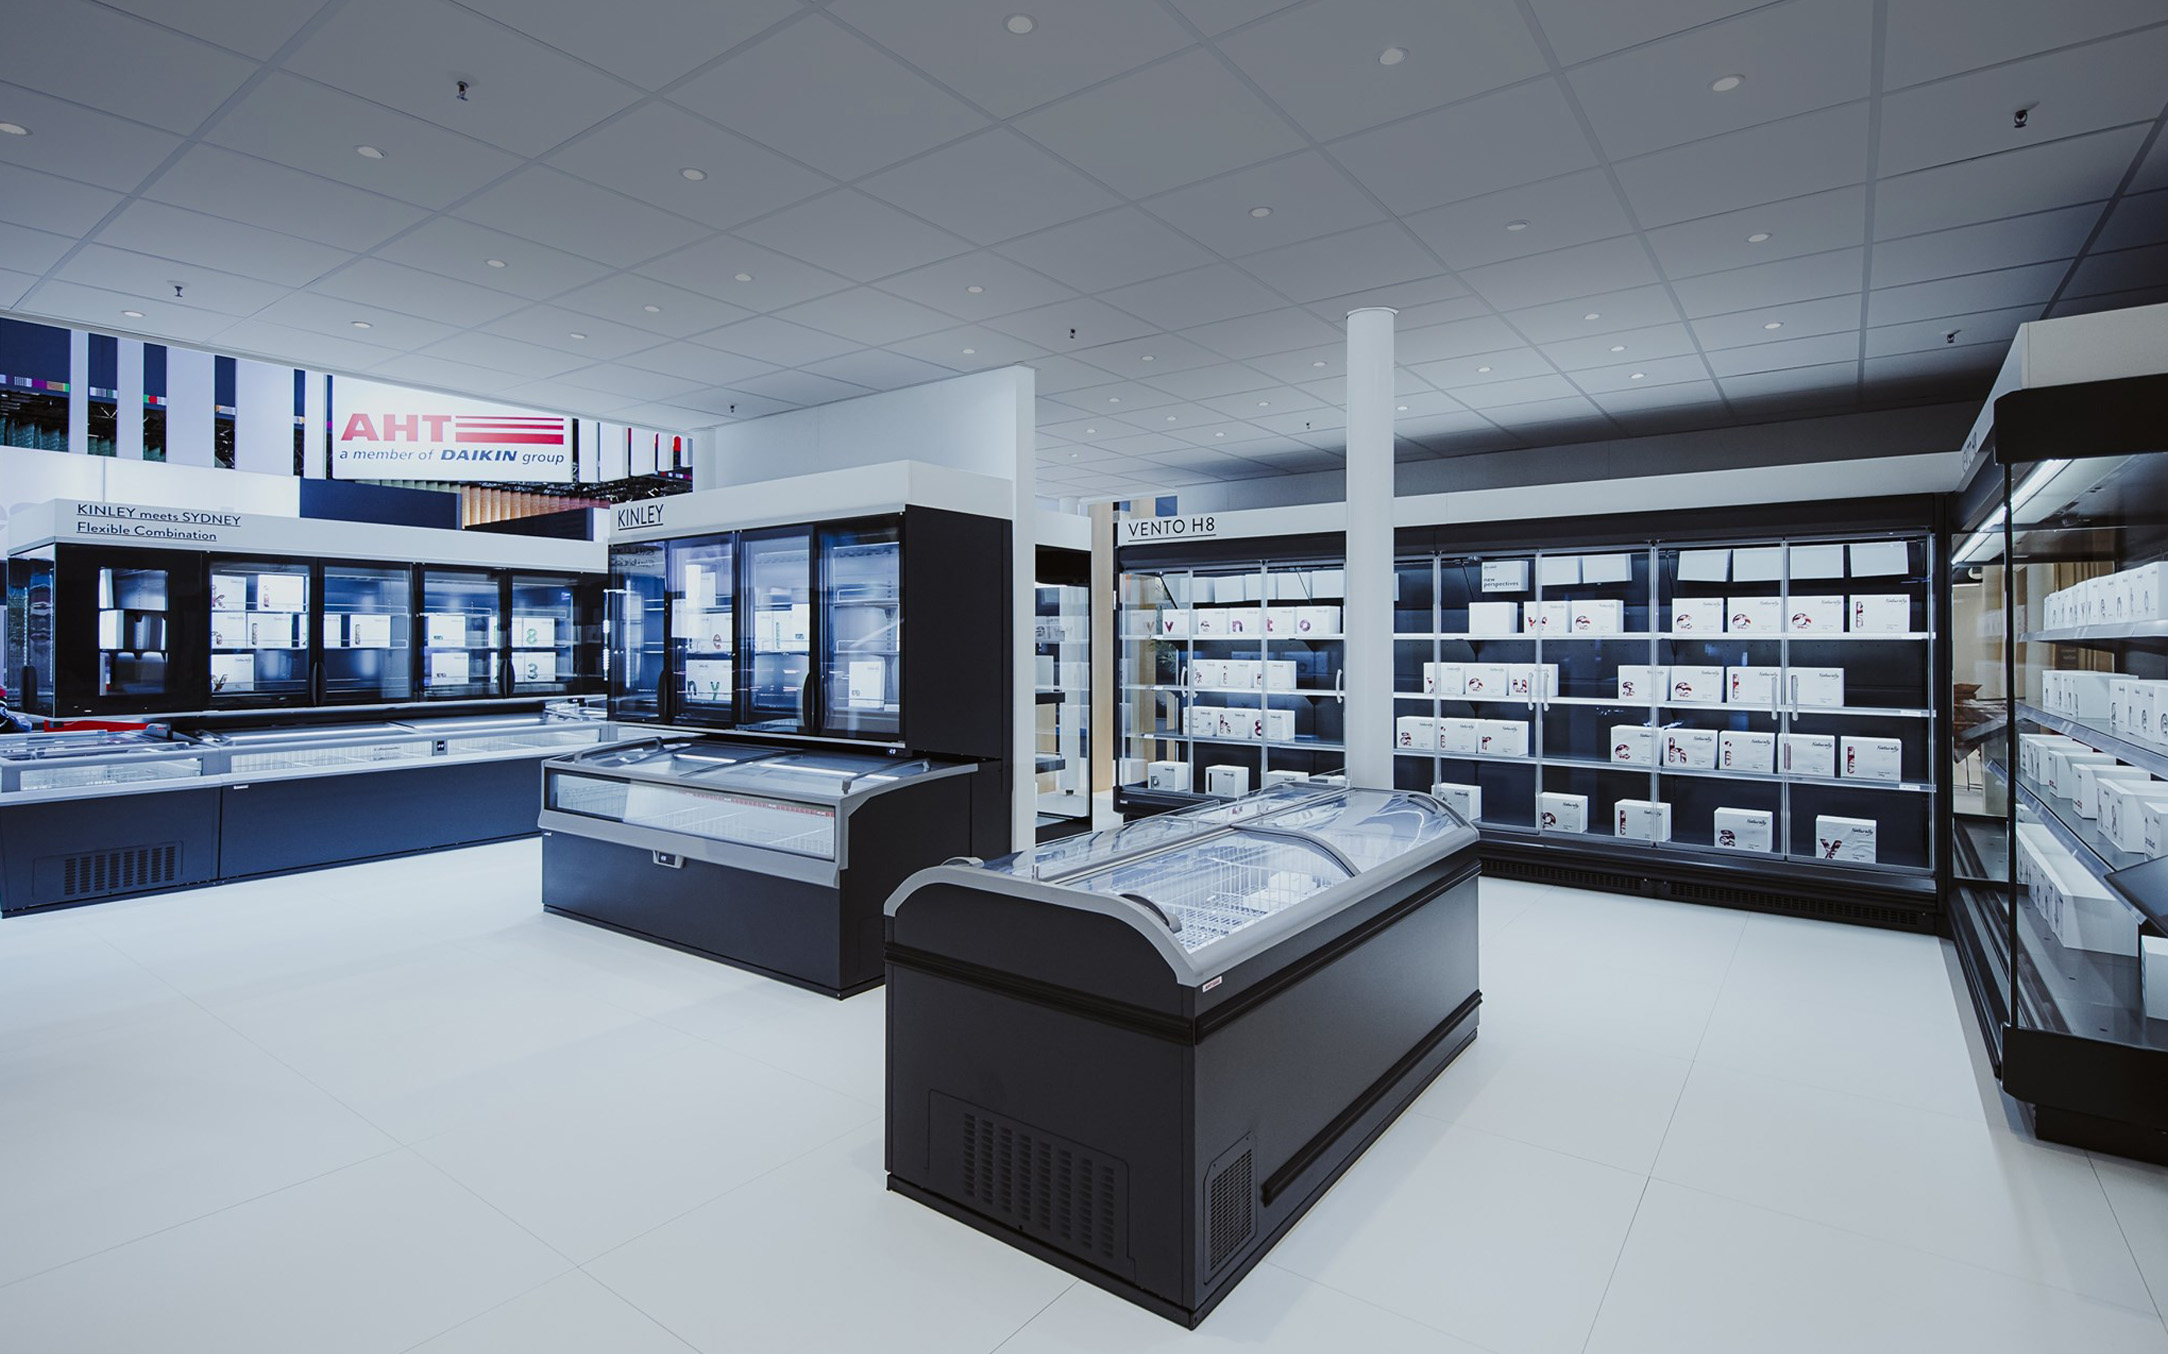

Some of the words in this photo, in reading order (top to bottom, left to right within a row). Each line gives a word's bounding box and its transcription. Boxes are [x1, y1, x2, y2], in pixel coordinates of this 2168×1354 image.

[341, 413, 452, 442] AHT
[339, 451, 348, 460] a
[353, 449, 412, 460] member
[421, 449, 434, 460] of
[440, 450, 518, 462] DAIKIN
[522, 455, 564, 465] group
[77, 503, 136, 518] KINLEY
[140, 511, 179, 521] meets
[182, 512, 241, 526] SYDNEY
[618, 504, 664, 527] KINLEY
[77, 521, 130, 535] Flexible
[134, 525, 217, 541] Combination
[1128, 519, 1186, 537] VENTO
[1192, 516, 1215, 532] H8
[1852, 827, 1874, 837] Naturally
